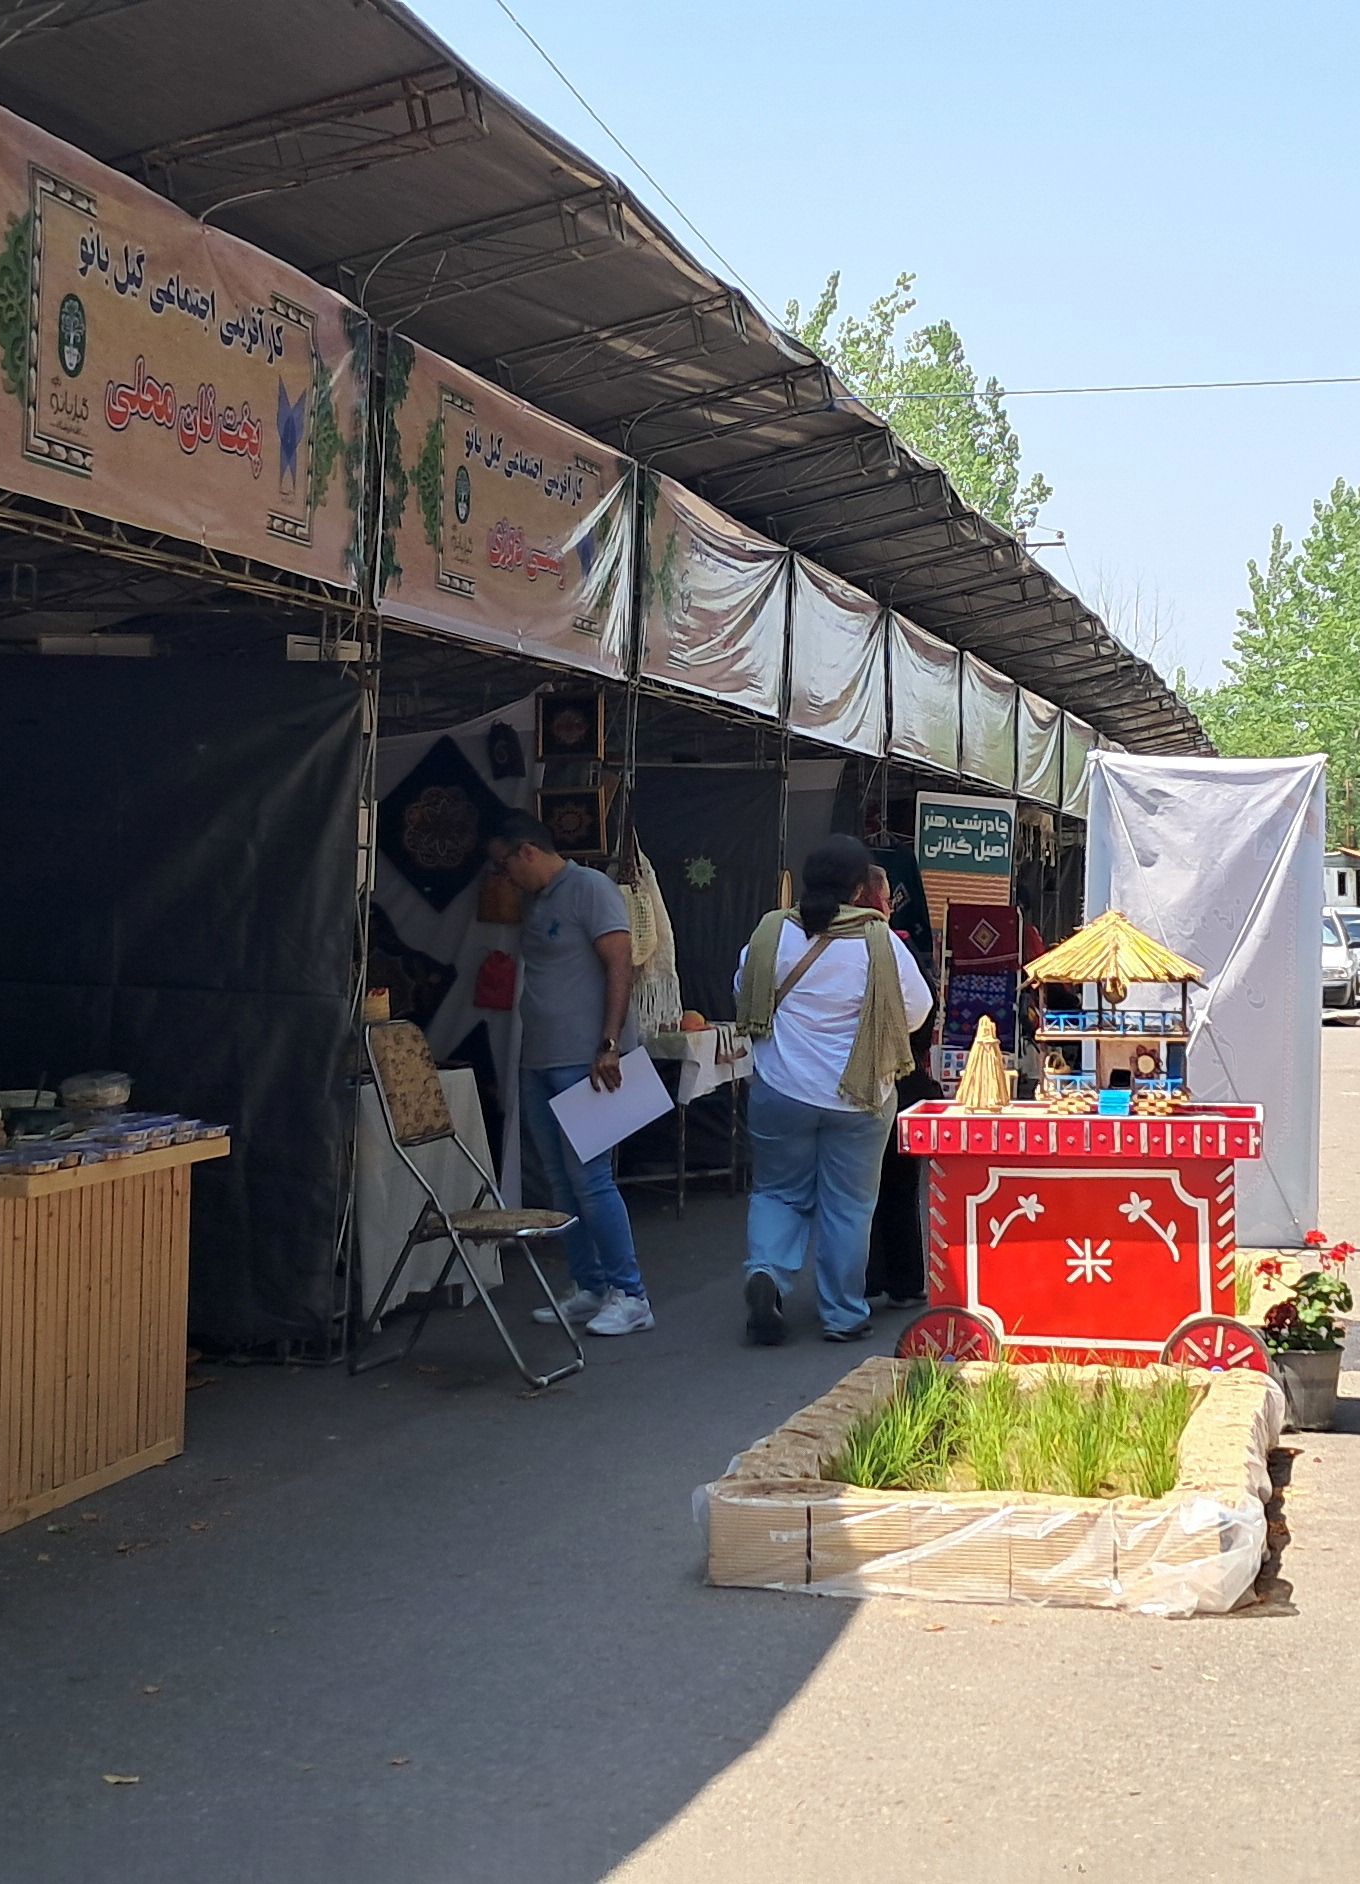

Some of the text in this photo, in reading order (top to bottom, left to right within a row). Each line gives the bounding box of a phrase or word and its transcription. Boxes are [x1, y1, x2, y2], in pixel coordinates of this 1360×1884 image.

[78, 225, 111, 287] بانو
[113, 244, 146, 299] گیل
[148, 273, 217, 333] اجتماعی
[104, 354, 264, 480] پخت نان محلی
[503, 449, 544, 487] اجتماعی
[924, 835, 1009, 862] اصیل گیلانی
